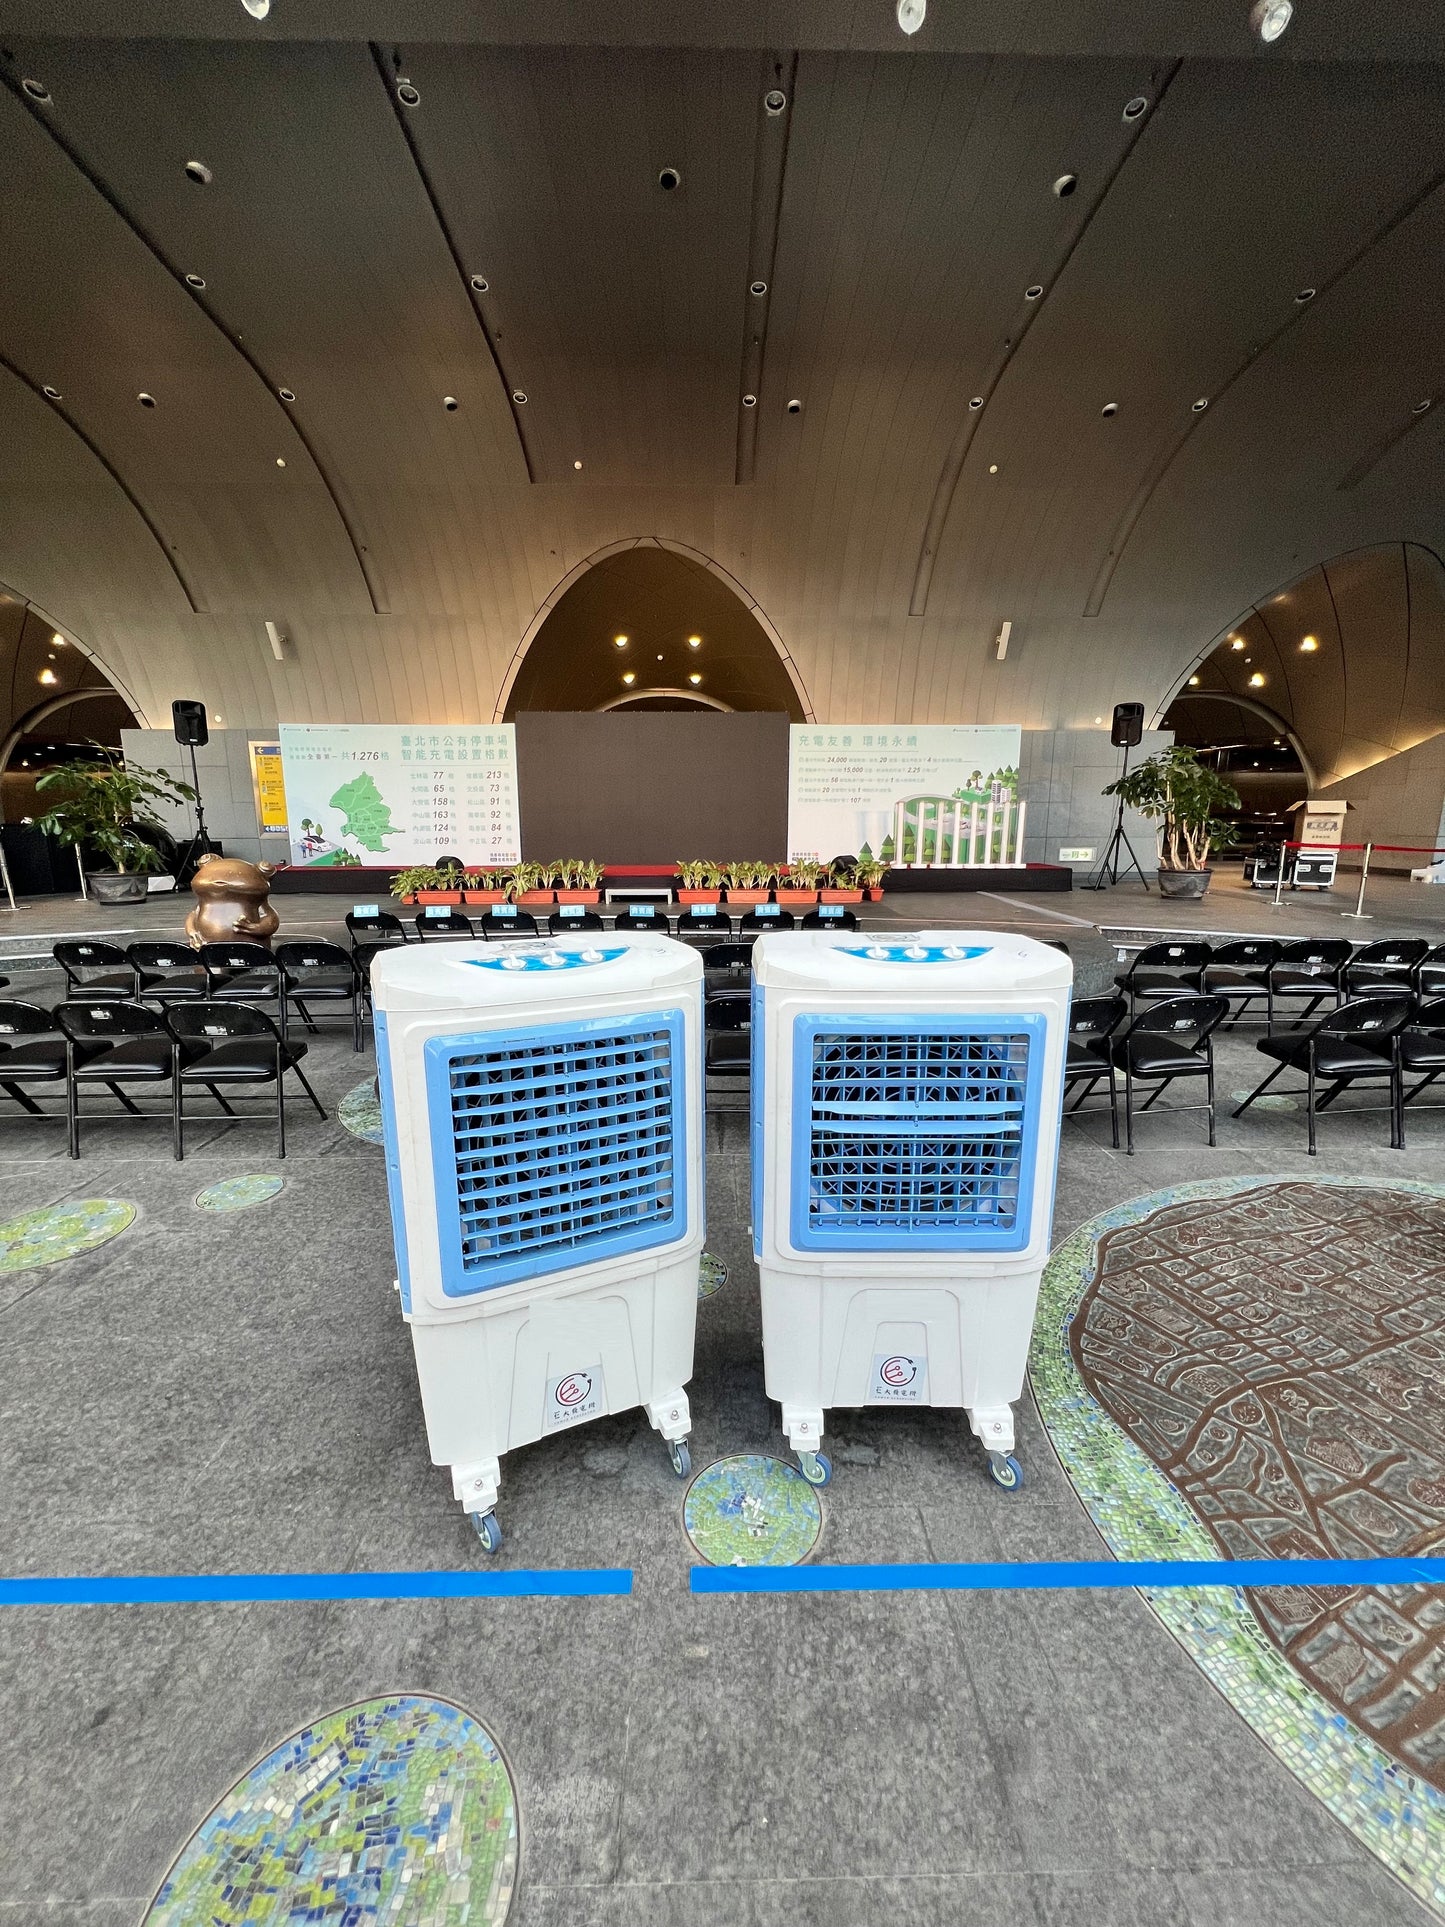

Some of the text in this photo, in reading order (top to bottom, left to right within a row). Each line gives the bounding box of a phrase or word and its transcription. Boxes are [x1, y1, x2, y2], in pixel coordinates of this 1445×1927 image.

[401, 735, 508, 747] 臺北市公有停車場
[799, 735, 917, 747] 充電友善 環境永續
[433, 771, 444, 779] 77
[486, 771, 502, 779] 213
[434, 784, 445, 793] 65
[490, 784, 500, 792] 73
[432, 797, 448, 806] 158
[490, 797, 500, 806] 91
[433, 811, 449, 819] 163
[490, 810, 501, 819] 92
[433, 824, 448, 832] 124
[491, 823, 501, 832] 84
[434, 837, 450, 845] 109
[491, 836, 502, 845] 27
